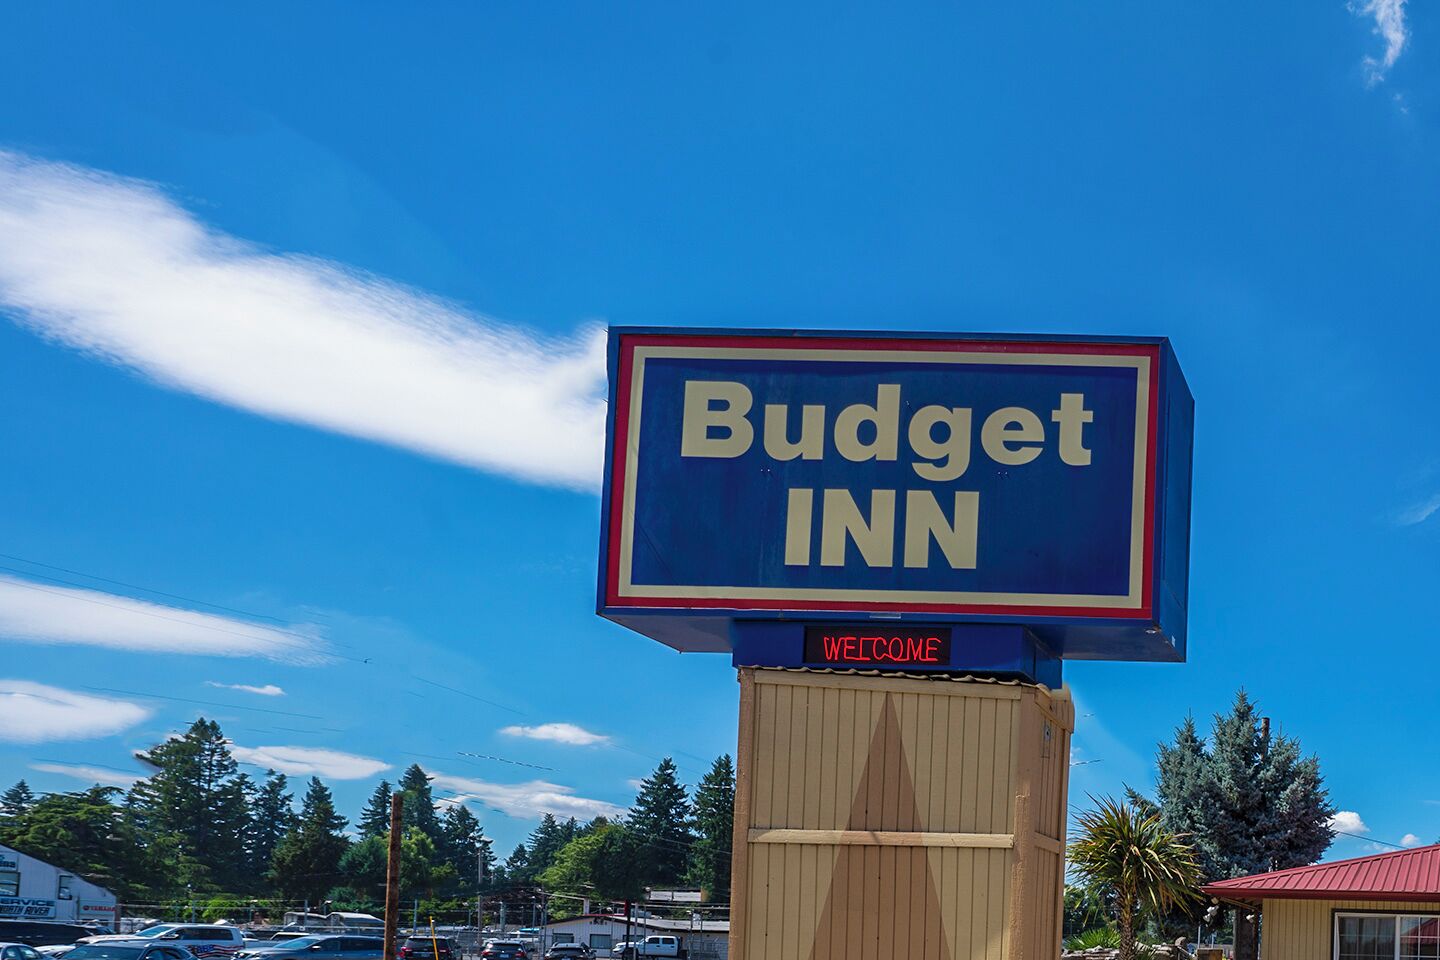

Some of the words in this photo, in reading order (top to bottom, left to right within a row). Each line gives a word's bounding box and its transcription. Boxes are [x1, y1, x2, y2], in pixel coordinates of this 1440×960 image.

[681, 380, 1093, 481] Budget
[785, 488, 979, 569] INN
[823, 636, 942, 662] WELCOME
